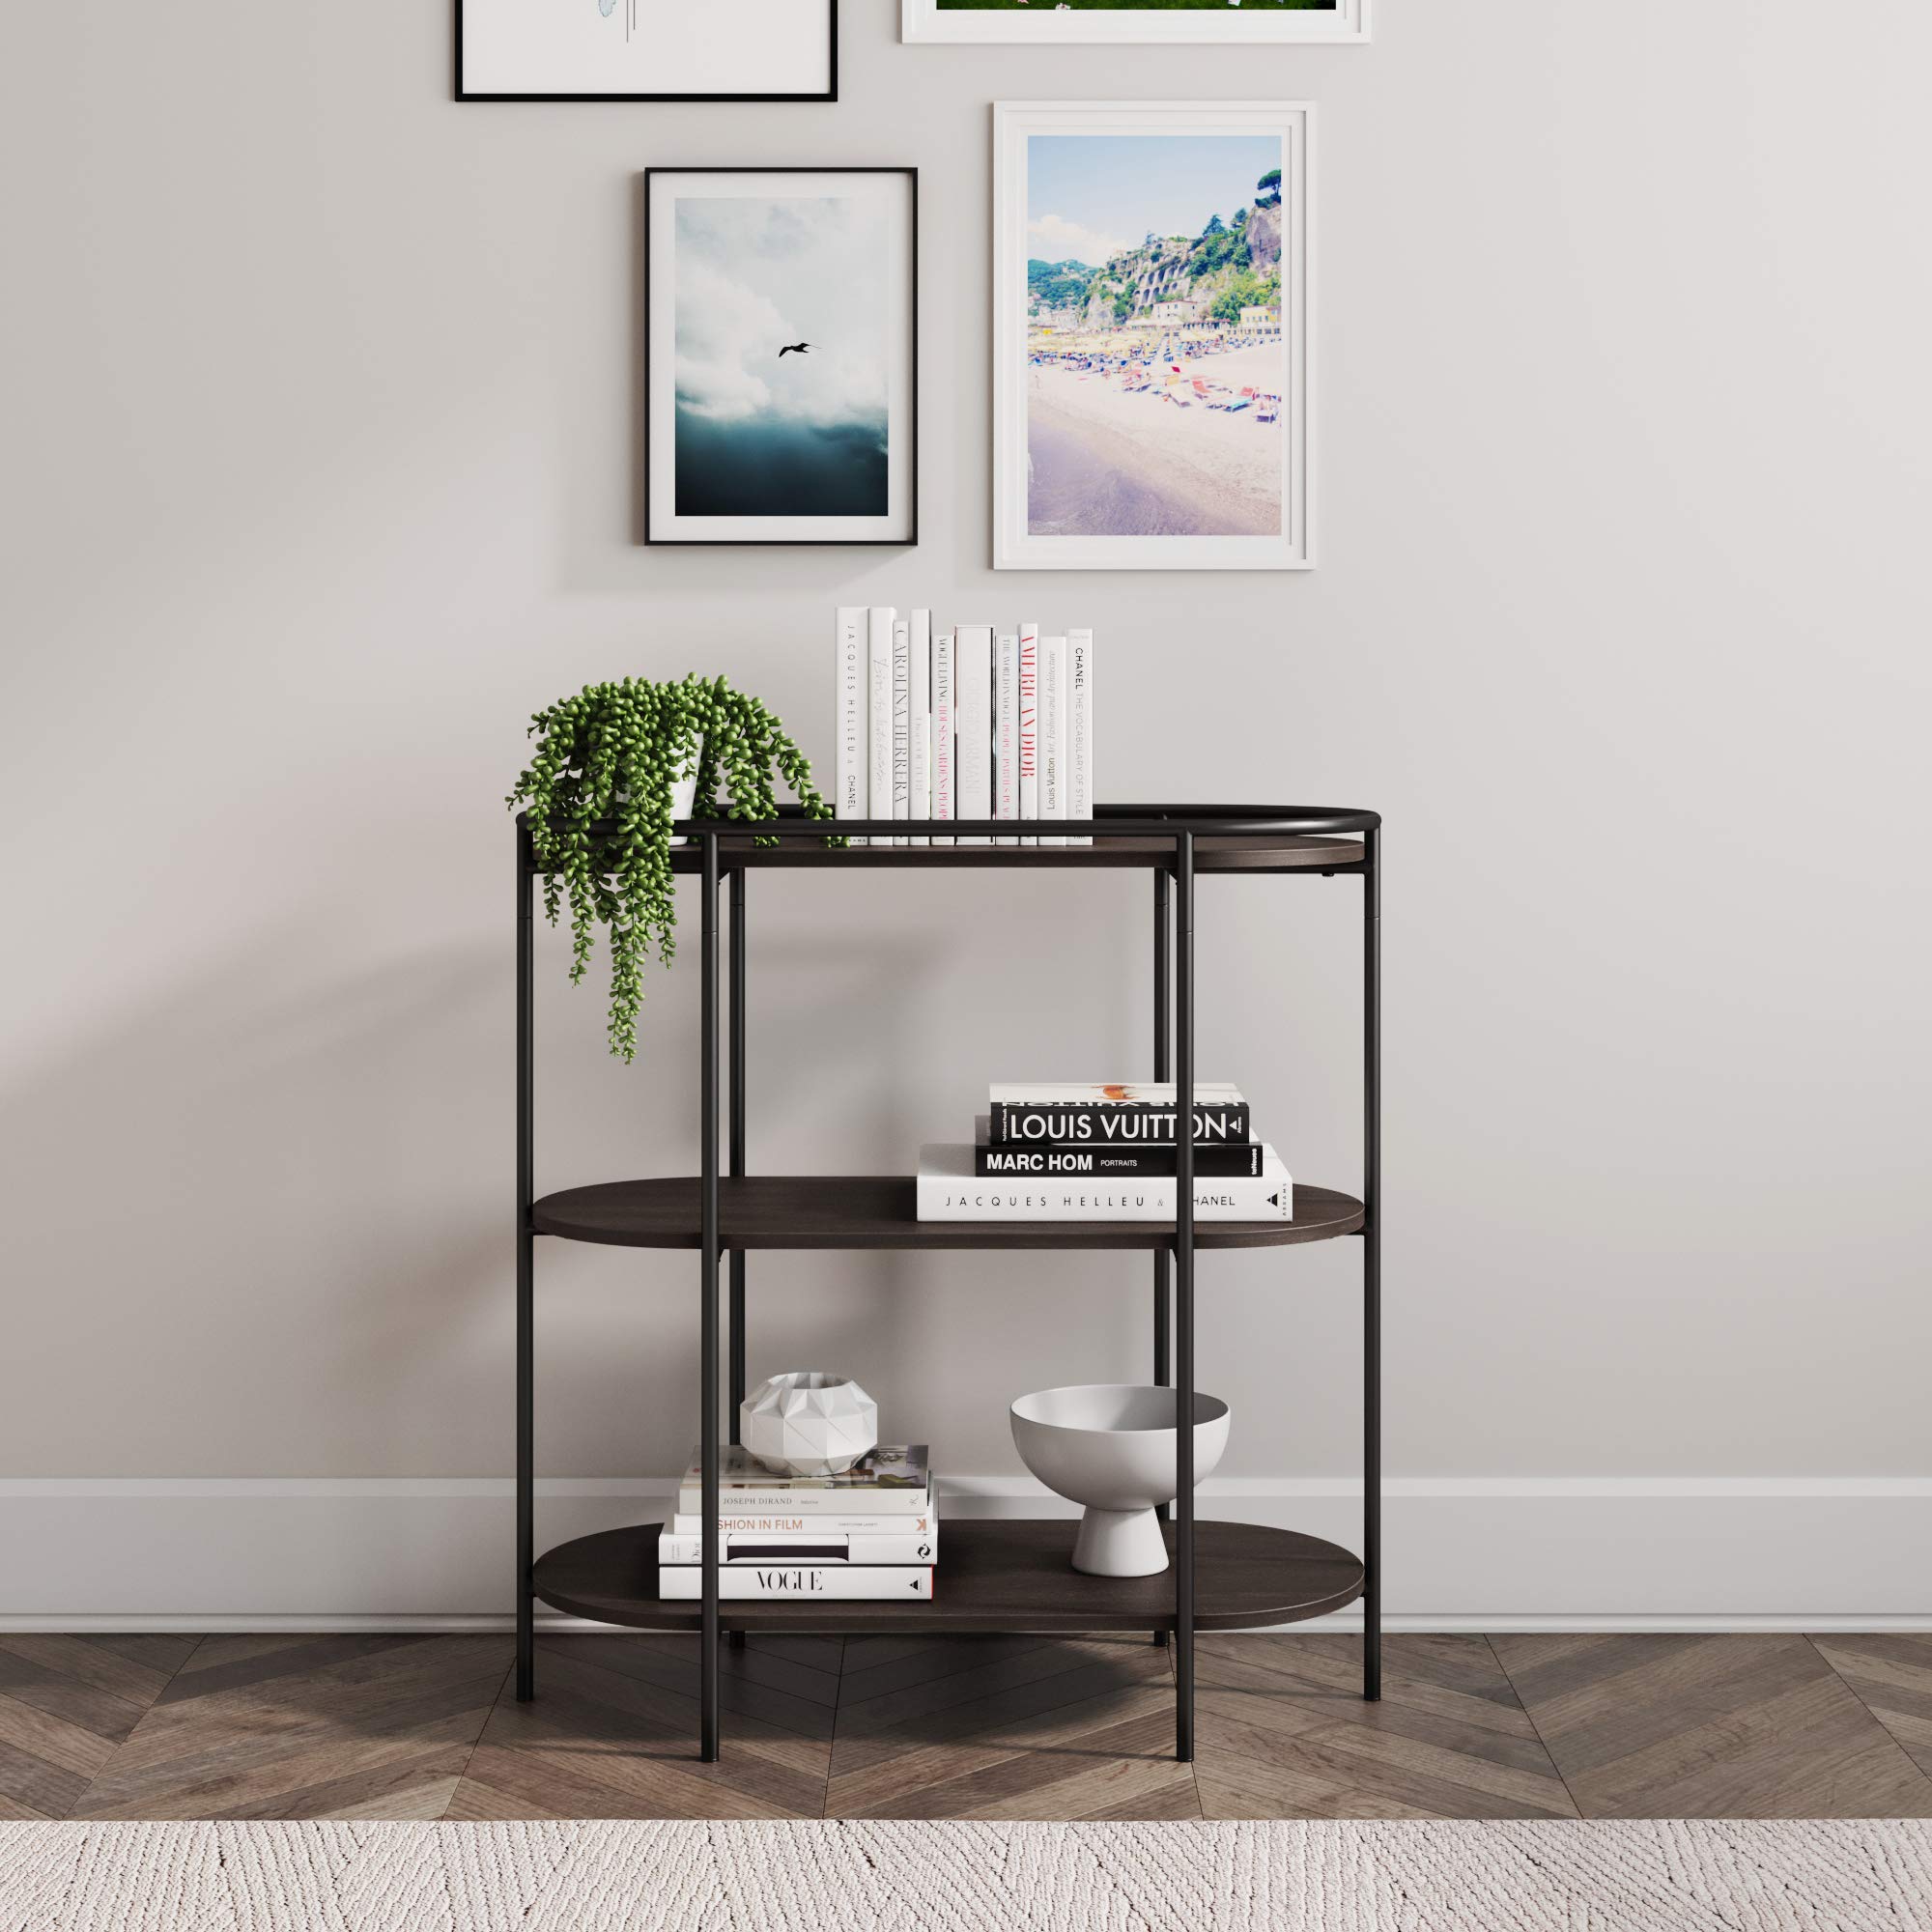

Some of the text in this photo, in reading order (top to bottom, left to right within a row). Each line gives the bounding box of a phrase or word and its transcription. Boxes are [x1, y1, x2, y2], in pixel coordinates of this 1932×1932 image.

[938, 639, 948, 668] VOGUE
[1075, 647, 1084, 690] CHANEL
[938, 669, 948, 702] LIVING
[1021, 636, 1036, 778] AMERICAN DIOR
[1075, 693, 1084, 711] THE
[895, 629, 908, 803] CAROLINA HERRERA
[1075, 712, 1084, 773] VOCABULARY
[966, 737, 979, 795] ARMANI
[848, 775, 857, 810] CHANEL
[1075, 775, 1084, 787] OF
[1075, 788, 1084, 815] STYLE
[1010, 1114, 1093, 1139] LOUIS
[986, 1153, 1043, 1171] MARC
[1048, 1153, 1093, 1171] HOM
[946, 1196, 1047, 1207] JACQUES
[1064, 1196, 1145, 1207] HELLEU
[1193, 1196, 1236, 1207] HANEL
[723, 1497, 756, 1506] JOSEPH
[758, 1497, 793, 1506] DIRAND
[719, 1520, 803, 1530] SHION IN FILM
[757, 1571, 823, 1591] VOGUE
